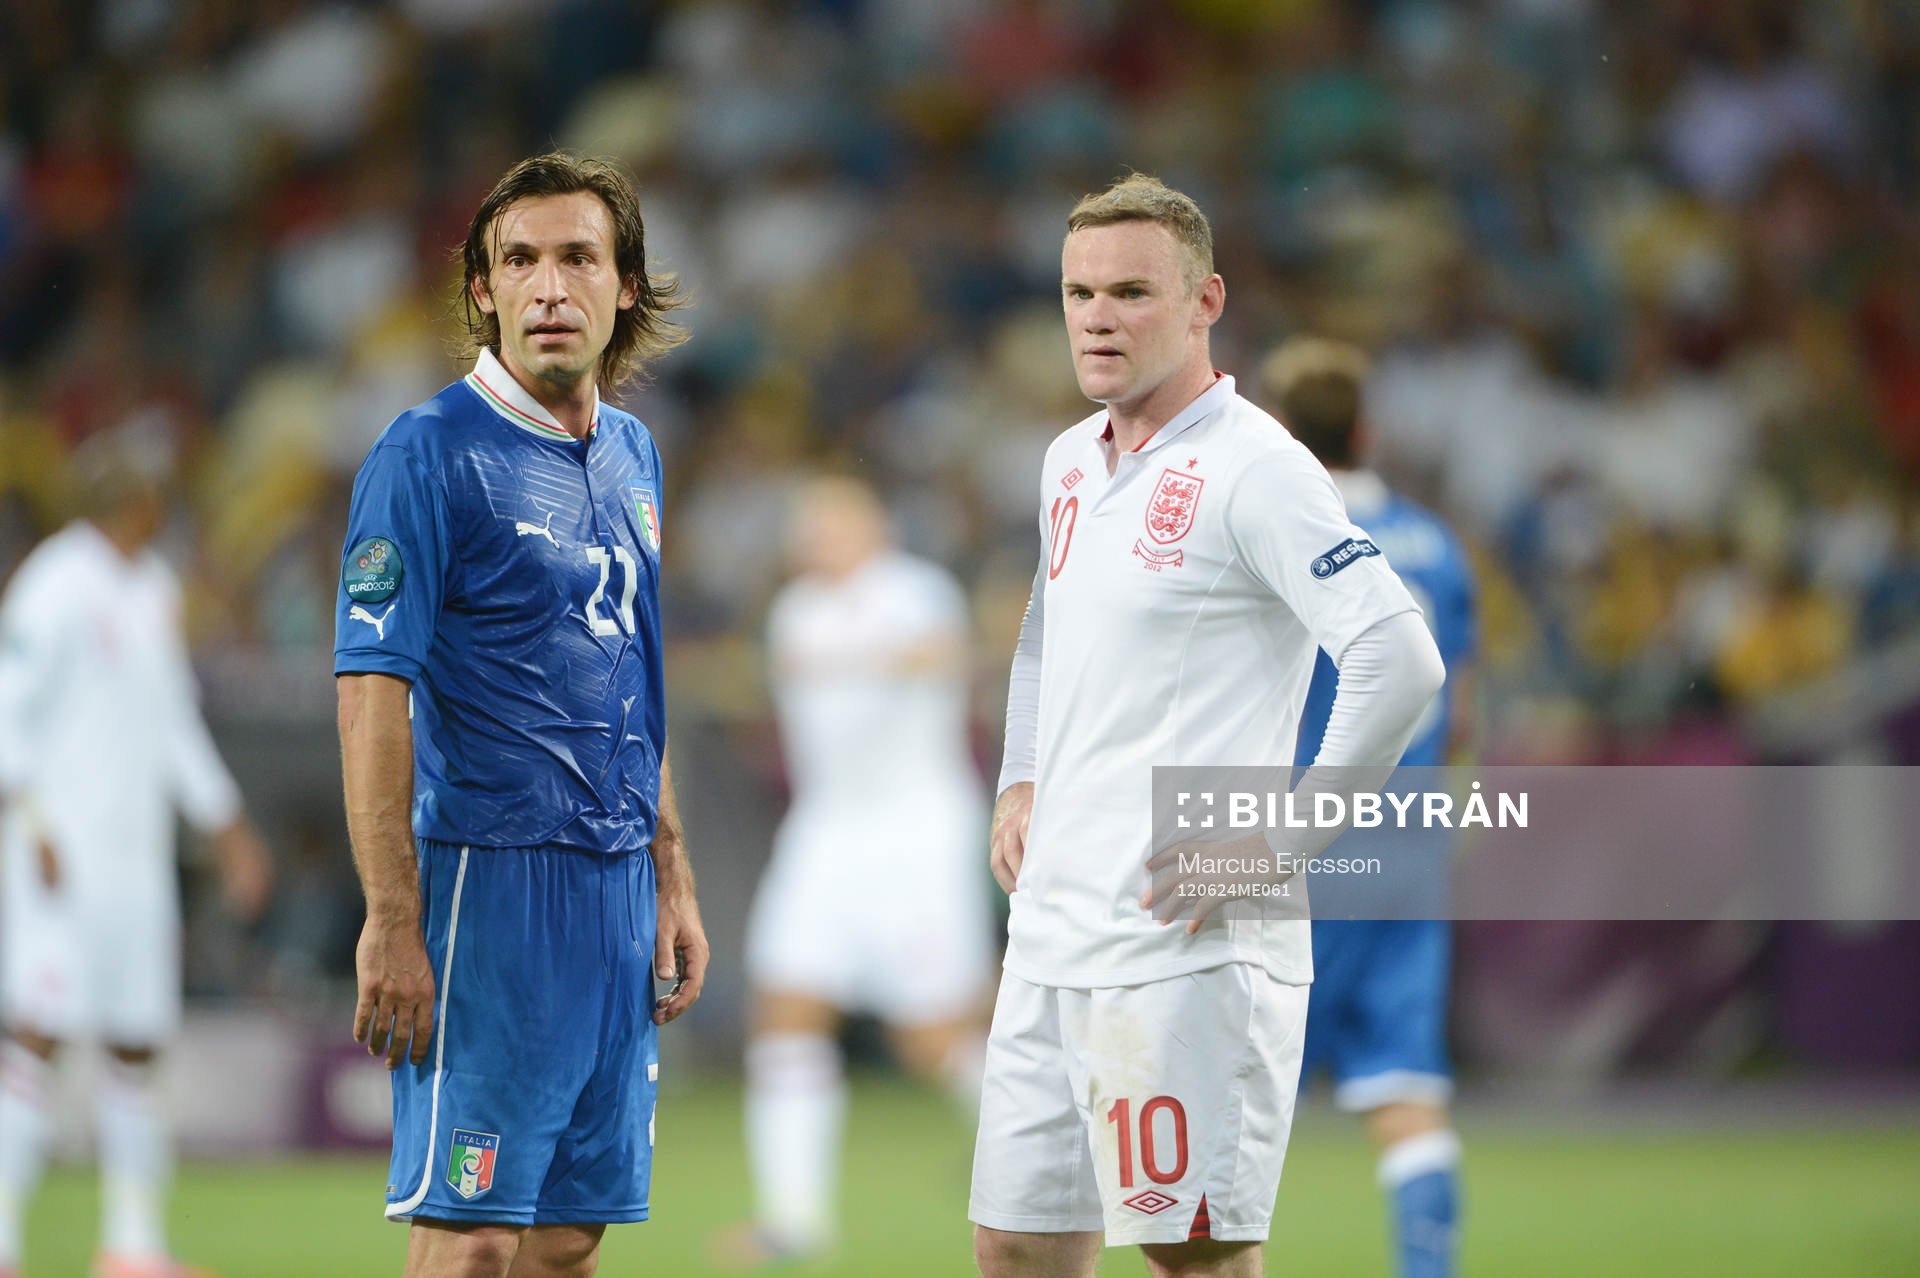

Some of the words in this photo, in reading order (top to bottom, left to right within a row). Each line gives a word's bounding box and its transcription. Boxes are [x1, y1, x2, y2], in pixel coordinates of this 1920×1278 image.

[1050, 496, 1078, 580] 10
[1144, 562, 1162, 572] 2012
[585, 546, 637, 636] 21
[459, 1135, 492, 1147] ITALIA
[1107, 1095, 1189, 1188] 10
